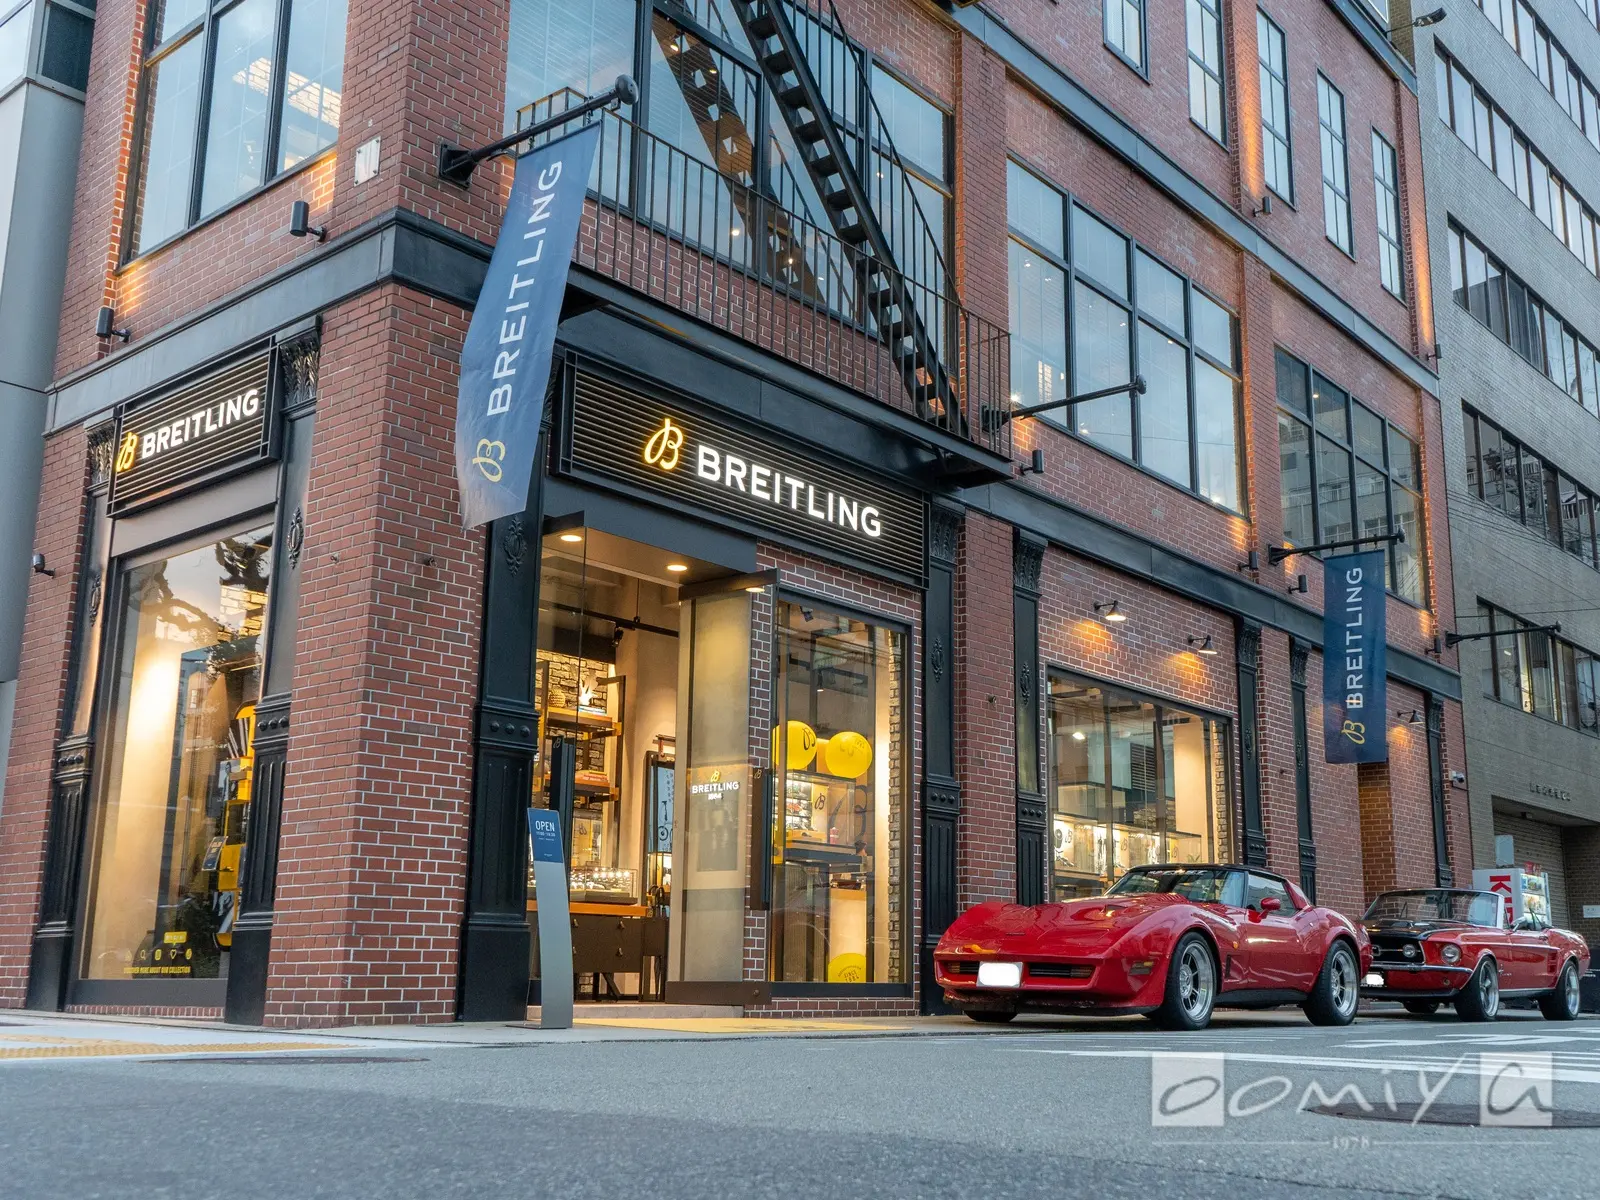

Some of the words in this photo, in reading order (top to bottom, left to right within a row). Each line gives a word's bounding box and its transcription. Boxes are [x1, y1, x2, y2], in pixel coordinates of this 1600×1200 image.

[486, 159, 563, 417] BREITLING
[142, 389, 259, 459] BREITLING
[697, 444, 882, 537] BREITLING
[1346, 567, 1363, 709] BREITLING
[535, 820, 555, 832] OPEN
[691, 781, 740, 794] BREITLING
